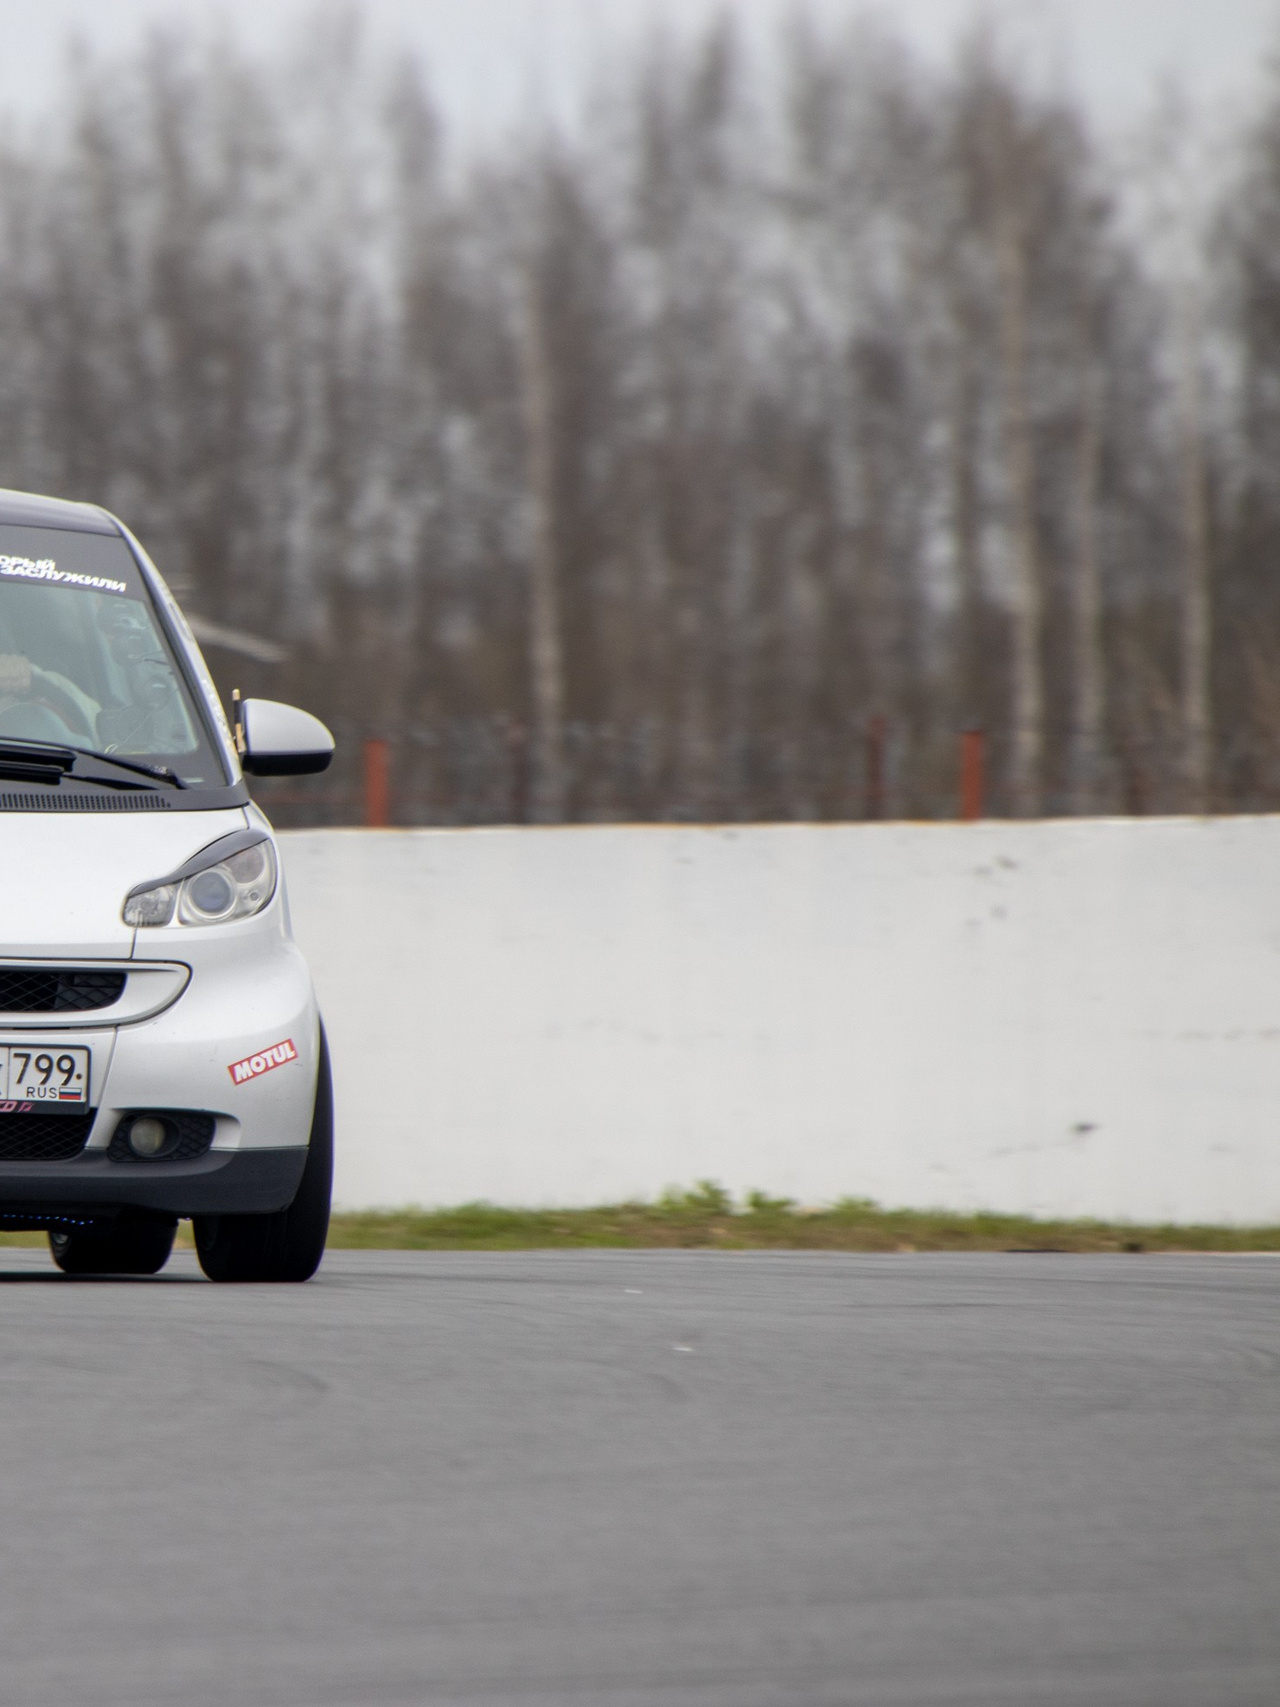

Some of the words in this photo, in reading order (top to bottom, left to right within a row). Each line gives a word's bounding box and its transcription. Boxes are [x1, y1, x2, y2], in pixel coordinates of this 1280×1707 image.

[0, 565, 127, 592] ЗАСЛУЖИЛИ
[13, 1053, 76, 1086] 799
[233, 1042, 296, 1083] MOTUL
[26, 1086, 57, 1099] RUS
